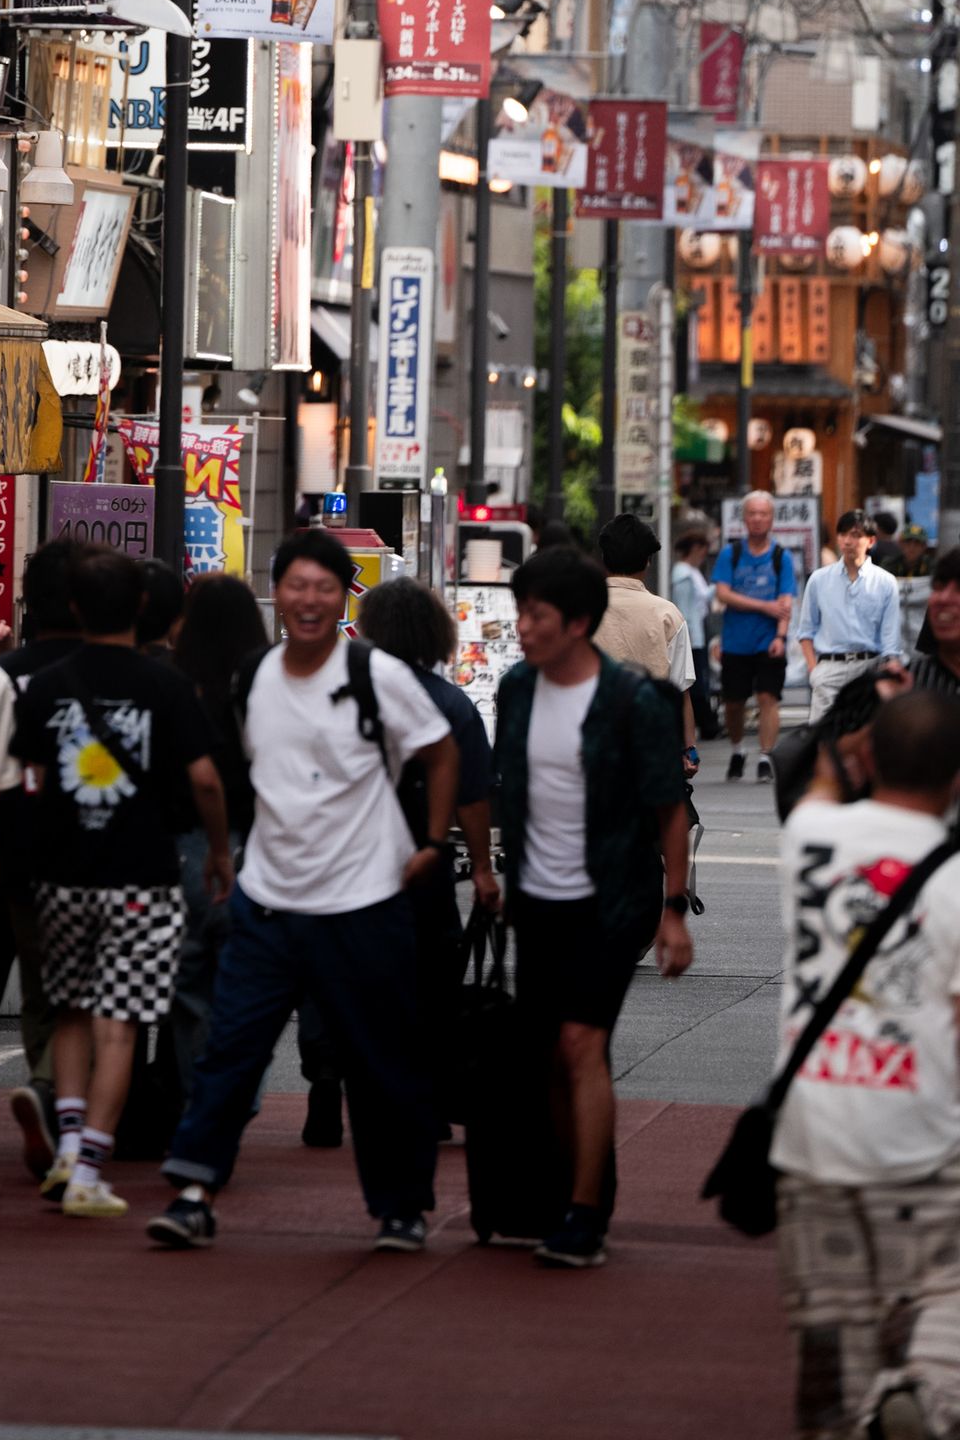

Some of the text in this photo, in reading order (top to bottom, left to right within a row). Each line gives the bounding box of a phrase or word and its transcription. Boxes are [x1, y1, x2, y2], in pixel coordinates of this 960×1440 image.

[387, 278, 420, 435] レインボーホテル
[110, 497, 148, 514] 60分
[58, 519, 148, 555] 4000円
